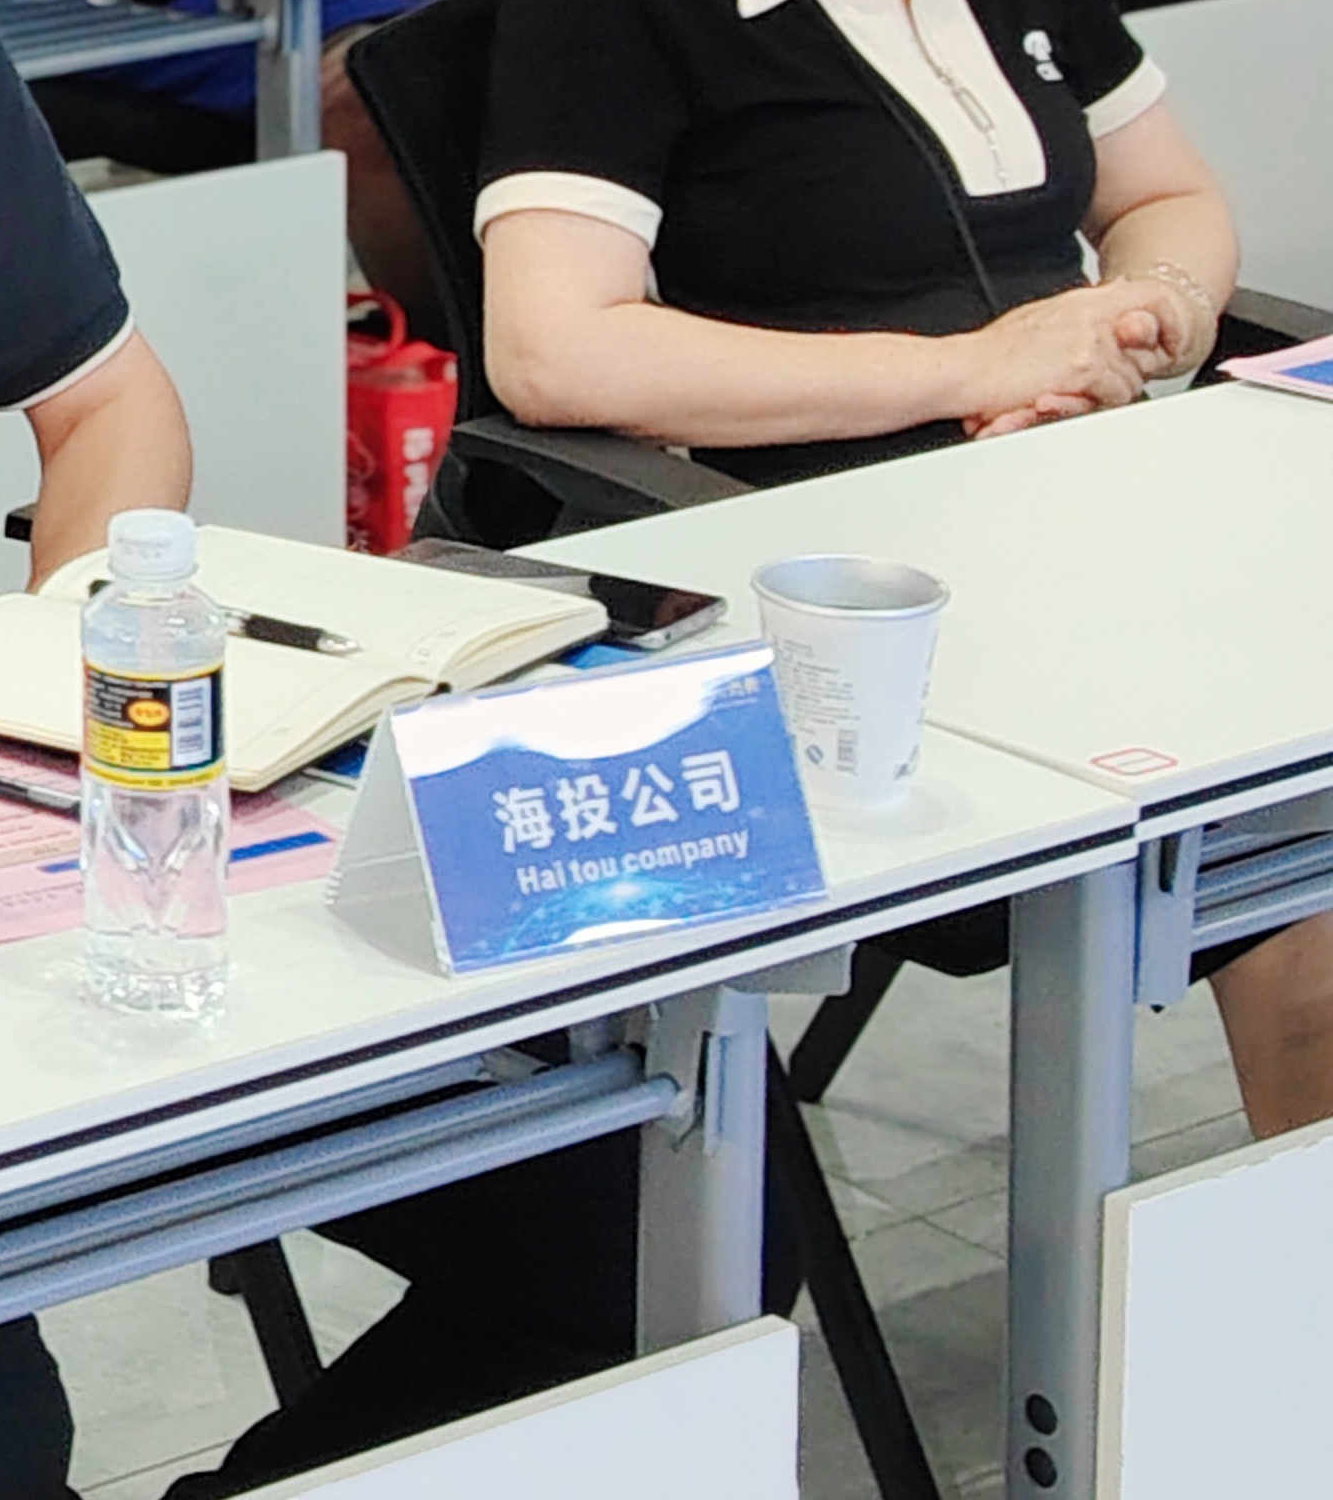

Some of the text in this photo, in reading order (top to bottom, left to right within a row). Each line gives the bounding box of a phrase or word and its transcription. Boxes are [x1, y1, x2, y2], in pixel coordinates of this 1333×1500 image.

[493, 751, 740, 853] 海投公司
[517, 830, 749, 895] Hai tou company
